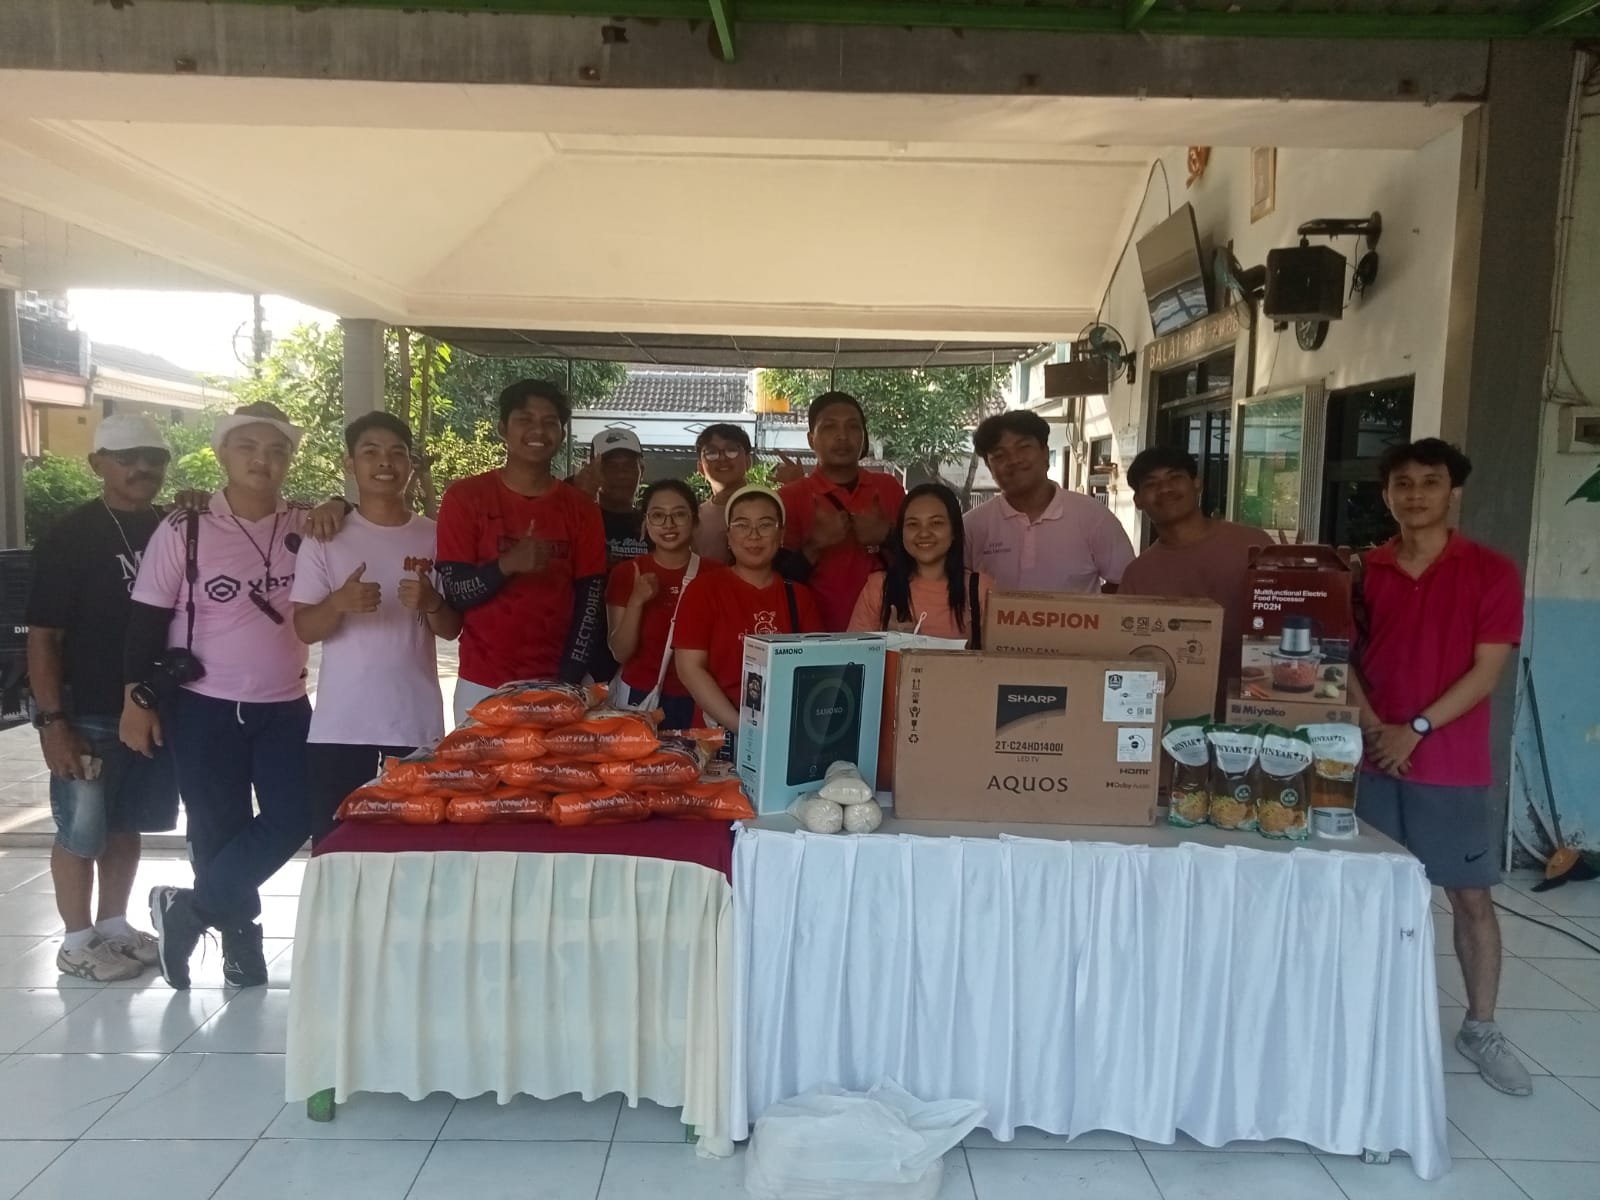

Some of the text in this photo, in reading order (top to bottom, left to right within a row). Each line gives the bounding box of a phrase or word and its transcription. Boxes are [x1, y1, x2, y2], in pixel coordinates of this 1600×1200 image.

[1254, 588, 1328, 598] Multifunctional Electric
[1252, 602, 1281, 611] FP02H
[996, 610, 1100, 630] MASPION
[774, 648, 803, 656] SAMONO
[1007, 694, 1057, 704] SHARP
[1243, 704, 1286, 718] Miyako
[987, 775, 1069, 794] AQUOS
